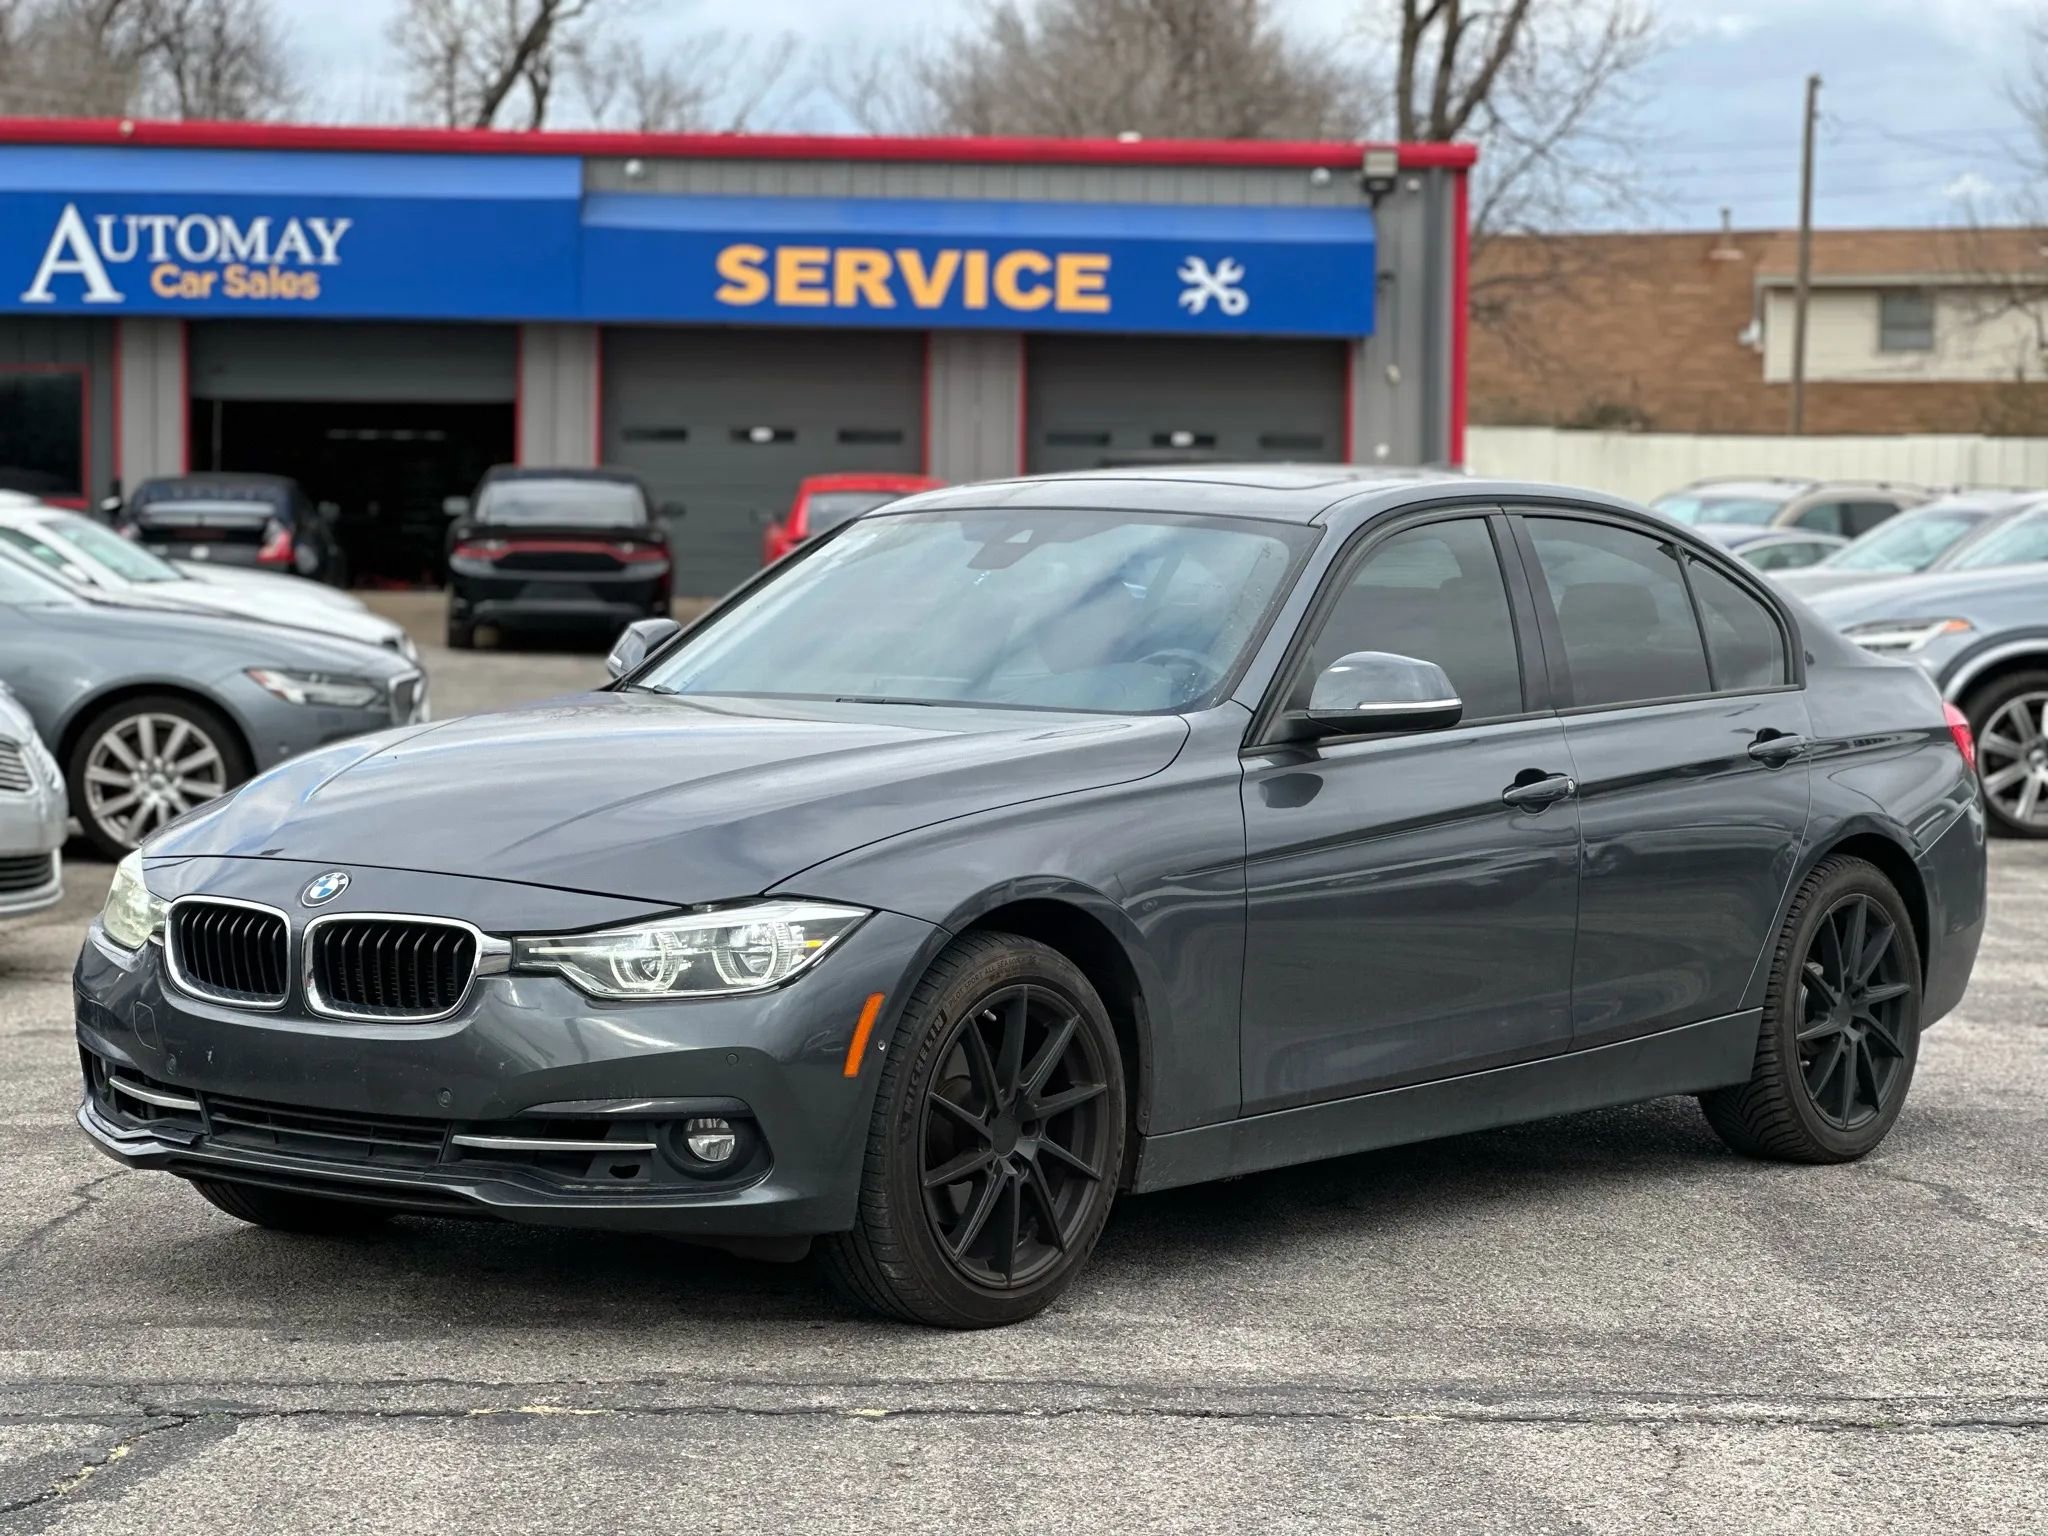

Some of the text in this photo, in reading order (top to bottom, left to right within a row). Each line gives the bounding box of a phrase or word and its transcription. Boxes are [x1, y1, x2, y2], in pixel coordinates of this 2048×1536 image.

[20, 203, 353, 303] AUTOMAY
[151, 264, 320, 300] Car Sales
[715, 243, 1111, 312] SERVICE
[903, 1014, 946, 1115] MICHELIN
